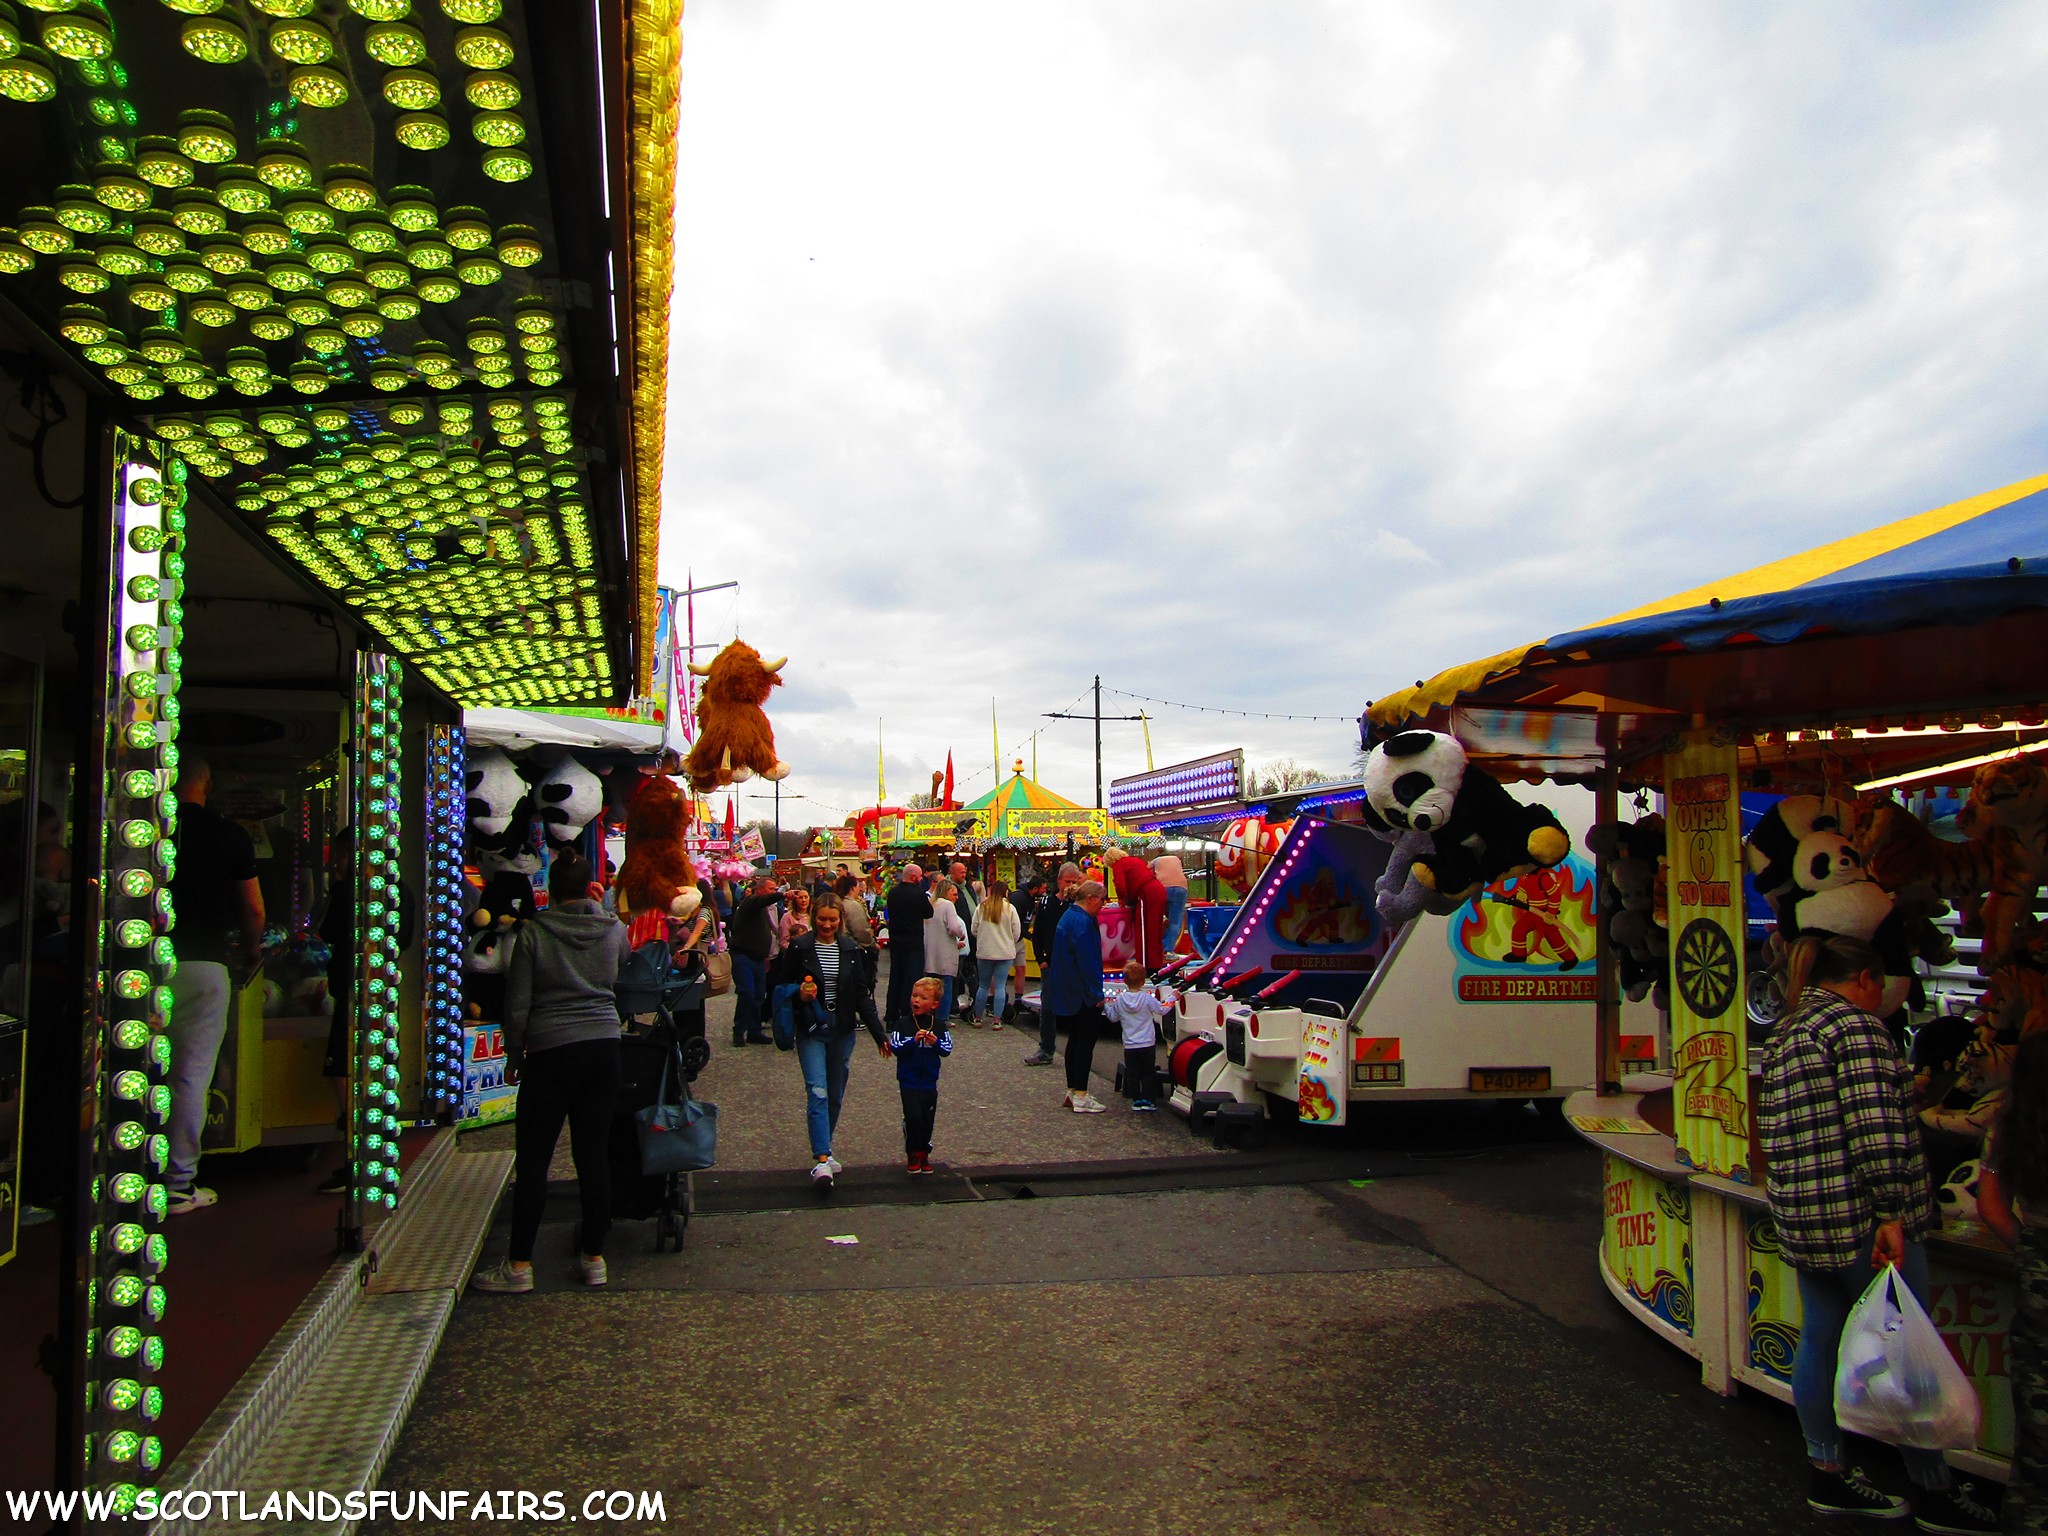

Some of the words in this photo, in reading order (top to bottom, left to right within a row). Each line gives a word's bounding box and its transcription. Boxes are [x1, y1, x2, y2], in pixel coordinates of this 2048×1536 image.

[1021, 811, 1092, 823] HOOK-A-DUCK
[1677, 802, 1727, 832] OVER
[1690, 831, 1714, 882] 6
[1678, 881, 1699, 906] TO
[1700, 881, 1730, 907] WIN
[1463, 980, 1500, 996] FIRE
[1686, 1038, 1728, 1060] PRIZE
[1483, 1074, 1513, 1088] P40
[1518, 1074, 1537, 1088] PP
[1688, 1094, 1710, 1110] EVERY
[1711, 1095, 1729, 1115] TIME
[1617, 1211, 1656, 1248] TIME
